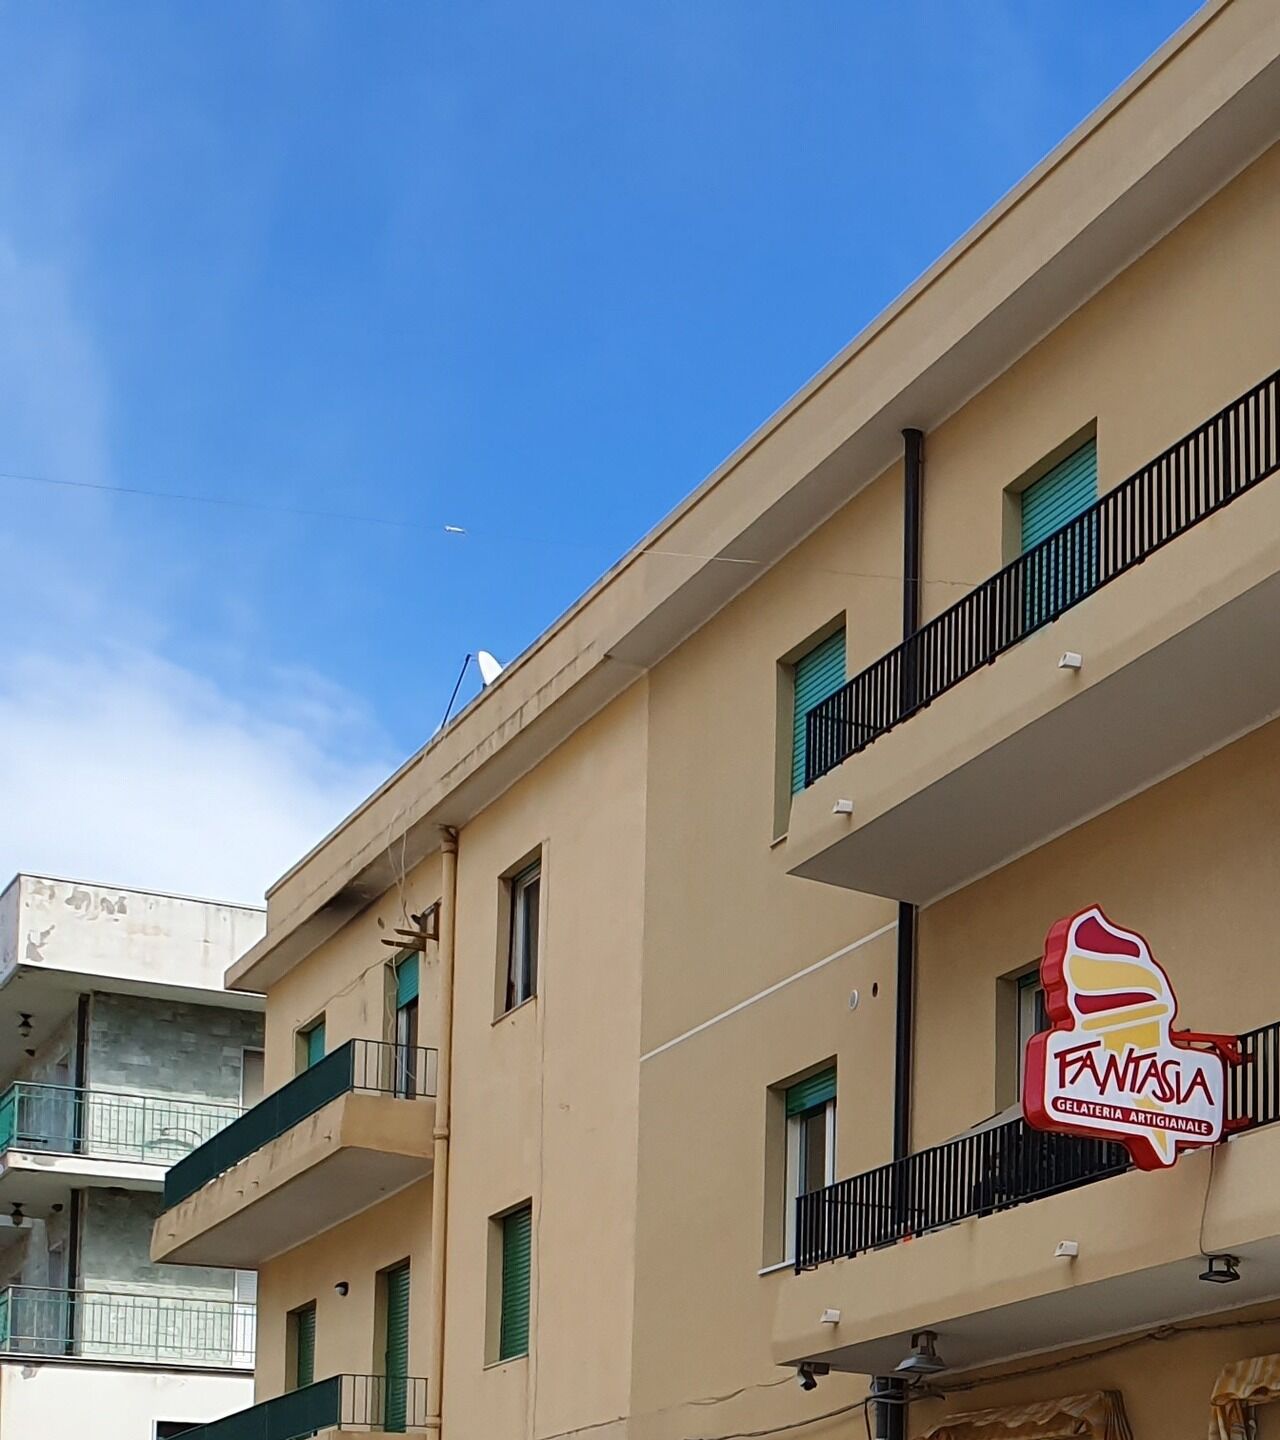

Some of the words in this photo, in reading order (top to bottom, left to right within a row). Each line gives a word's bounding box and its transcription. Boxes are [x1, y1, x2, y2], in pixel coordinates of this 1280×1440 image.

[1054, 1041, 1214, 1105] FANTASIA
[1056, 1099, 1123, 1121] GELATERIA
[1129, 1110, 1208, 1134] ARTIGIANALE
